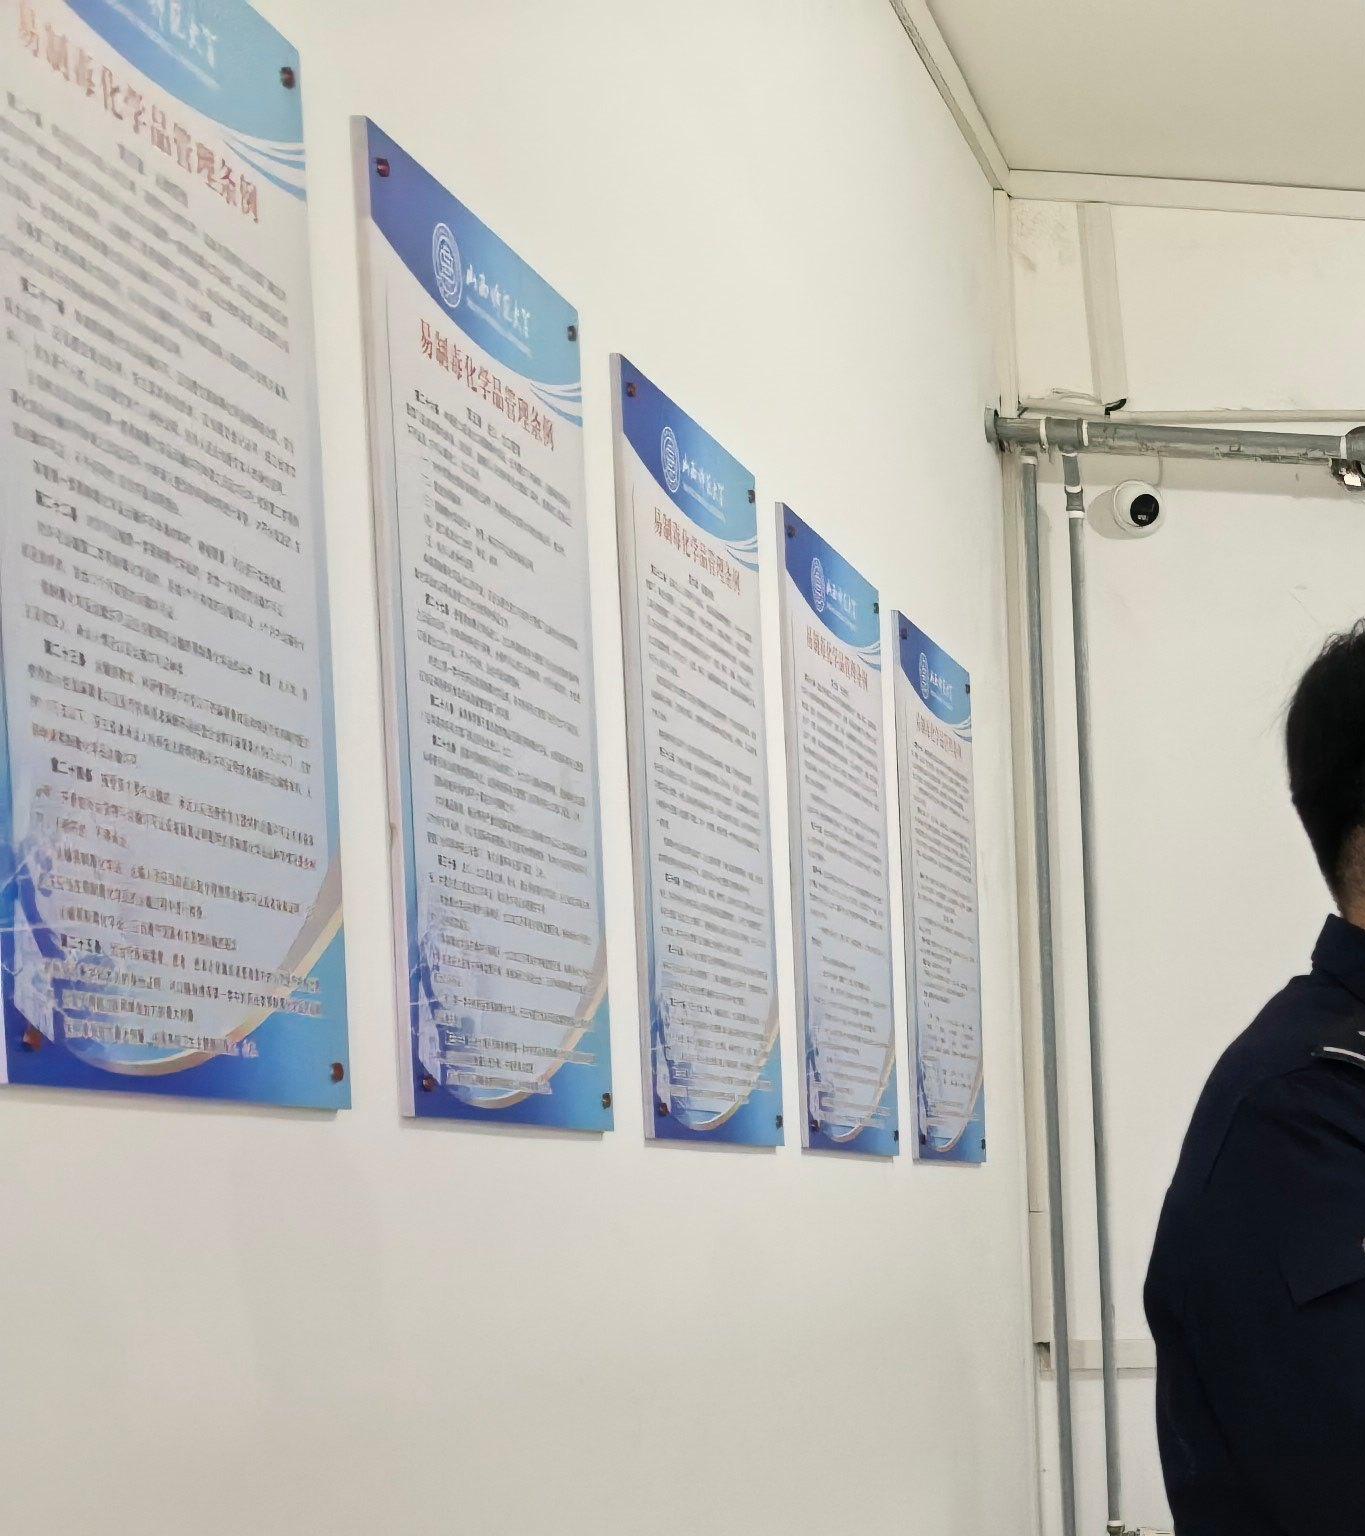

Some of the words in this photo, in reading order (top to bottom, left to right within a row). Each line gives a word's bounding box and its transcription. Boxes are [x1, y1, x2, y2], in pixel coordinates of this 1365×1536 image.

[420, 318, 555, 452] 易制毒化学品管理条例
